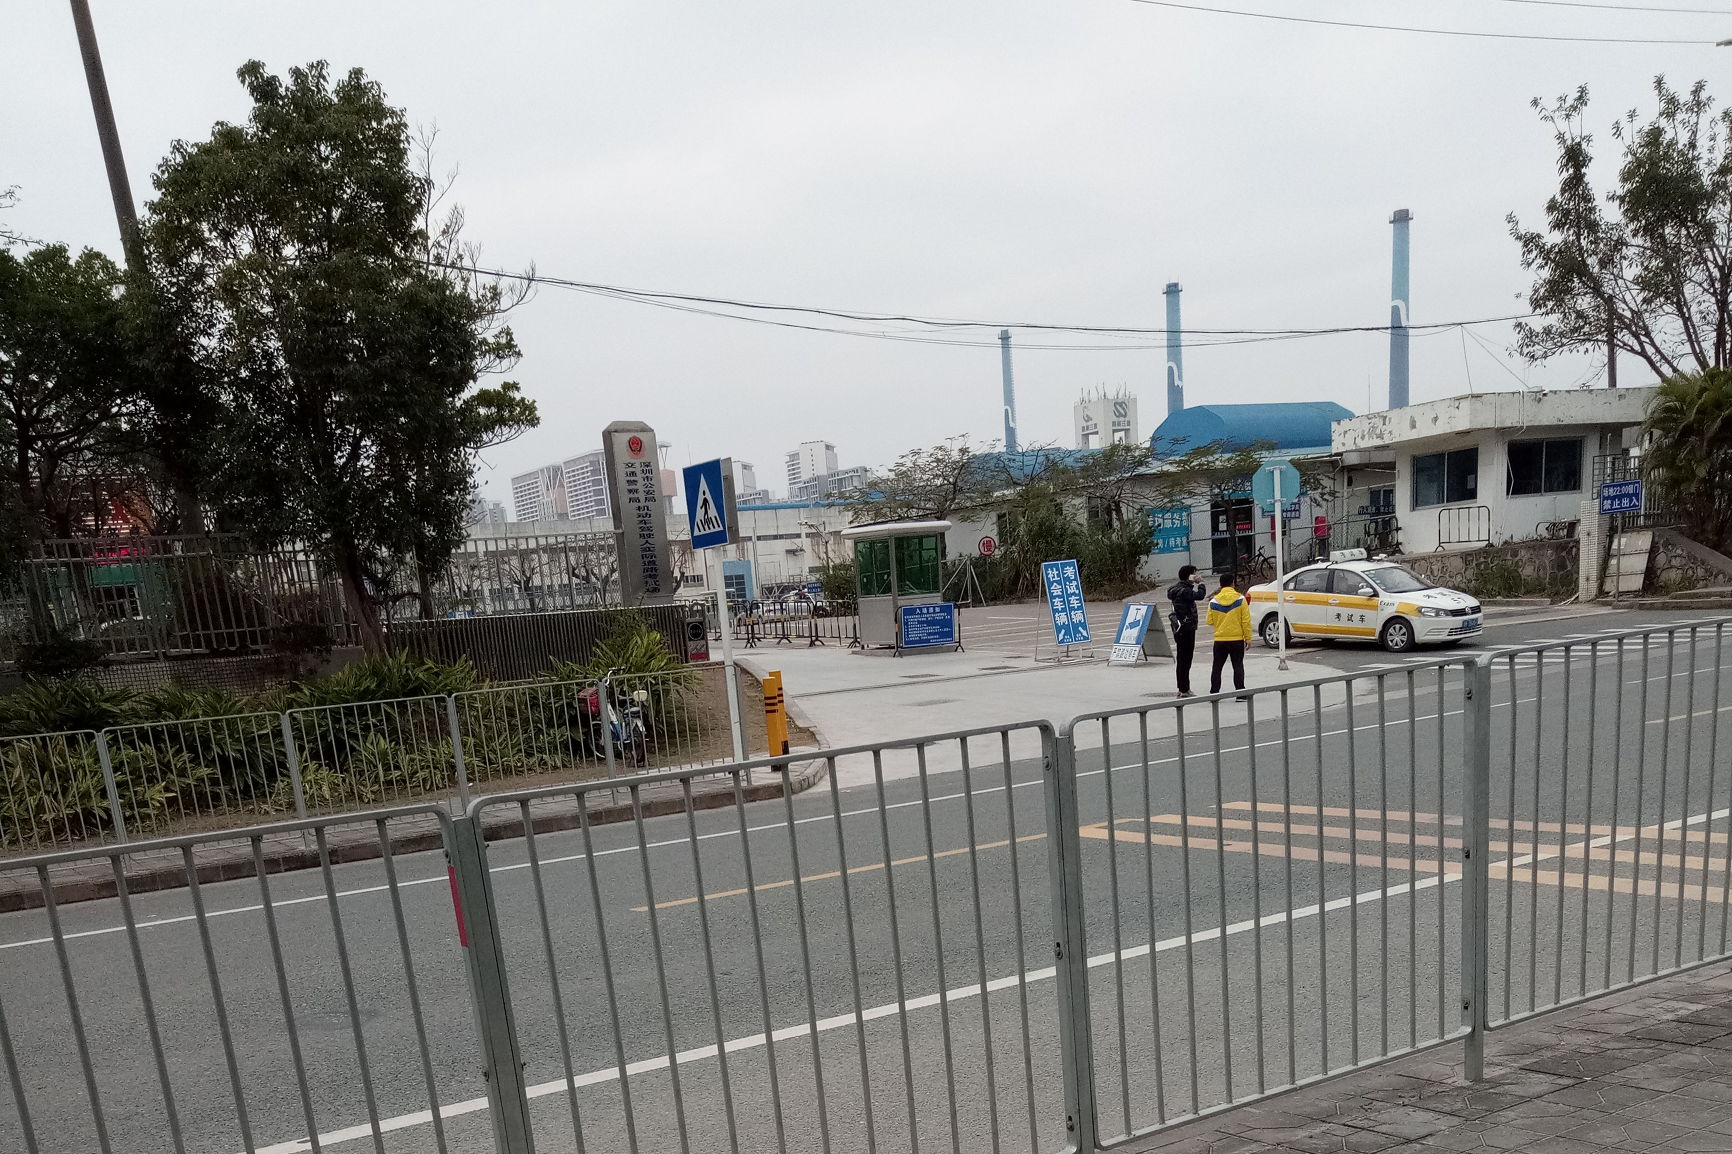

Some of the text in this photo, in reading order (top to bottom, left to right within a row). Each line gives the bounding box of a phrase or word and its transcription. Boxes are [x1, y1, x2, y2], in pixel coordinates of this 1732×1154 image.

[623, 462, 641, 504] 交通警察局
[1603, 496, 1639, 510] 禁止出入
[1047, 568, 1069, 626] 社会车辆
[1063, 565, 1085, 624] 考试车辆
[1334, 612, 1366, 623] 考试车
